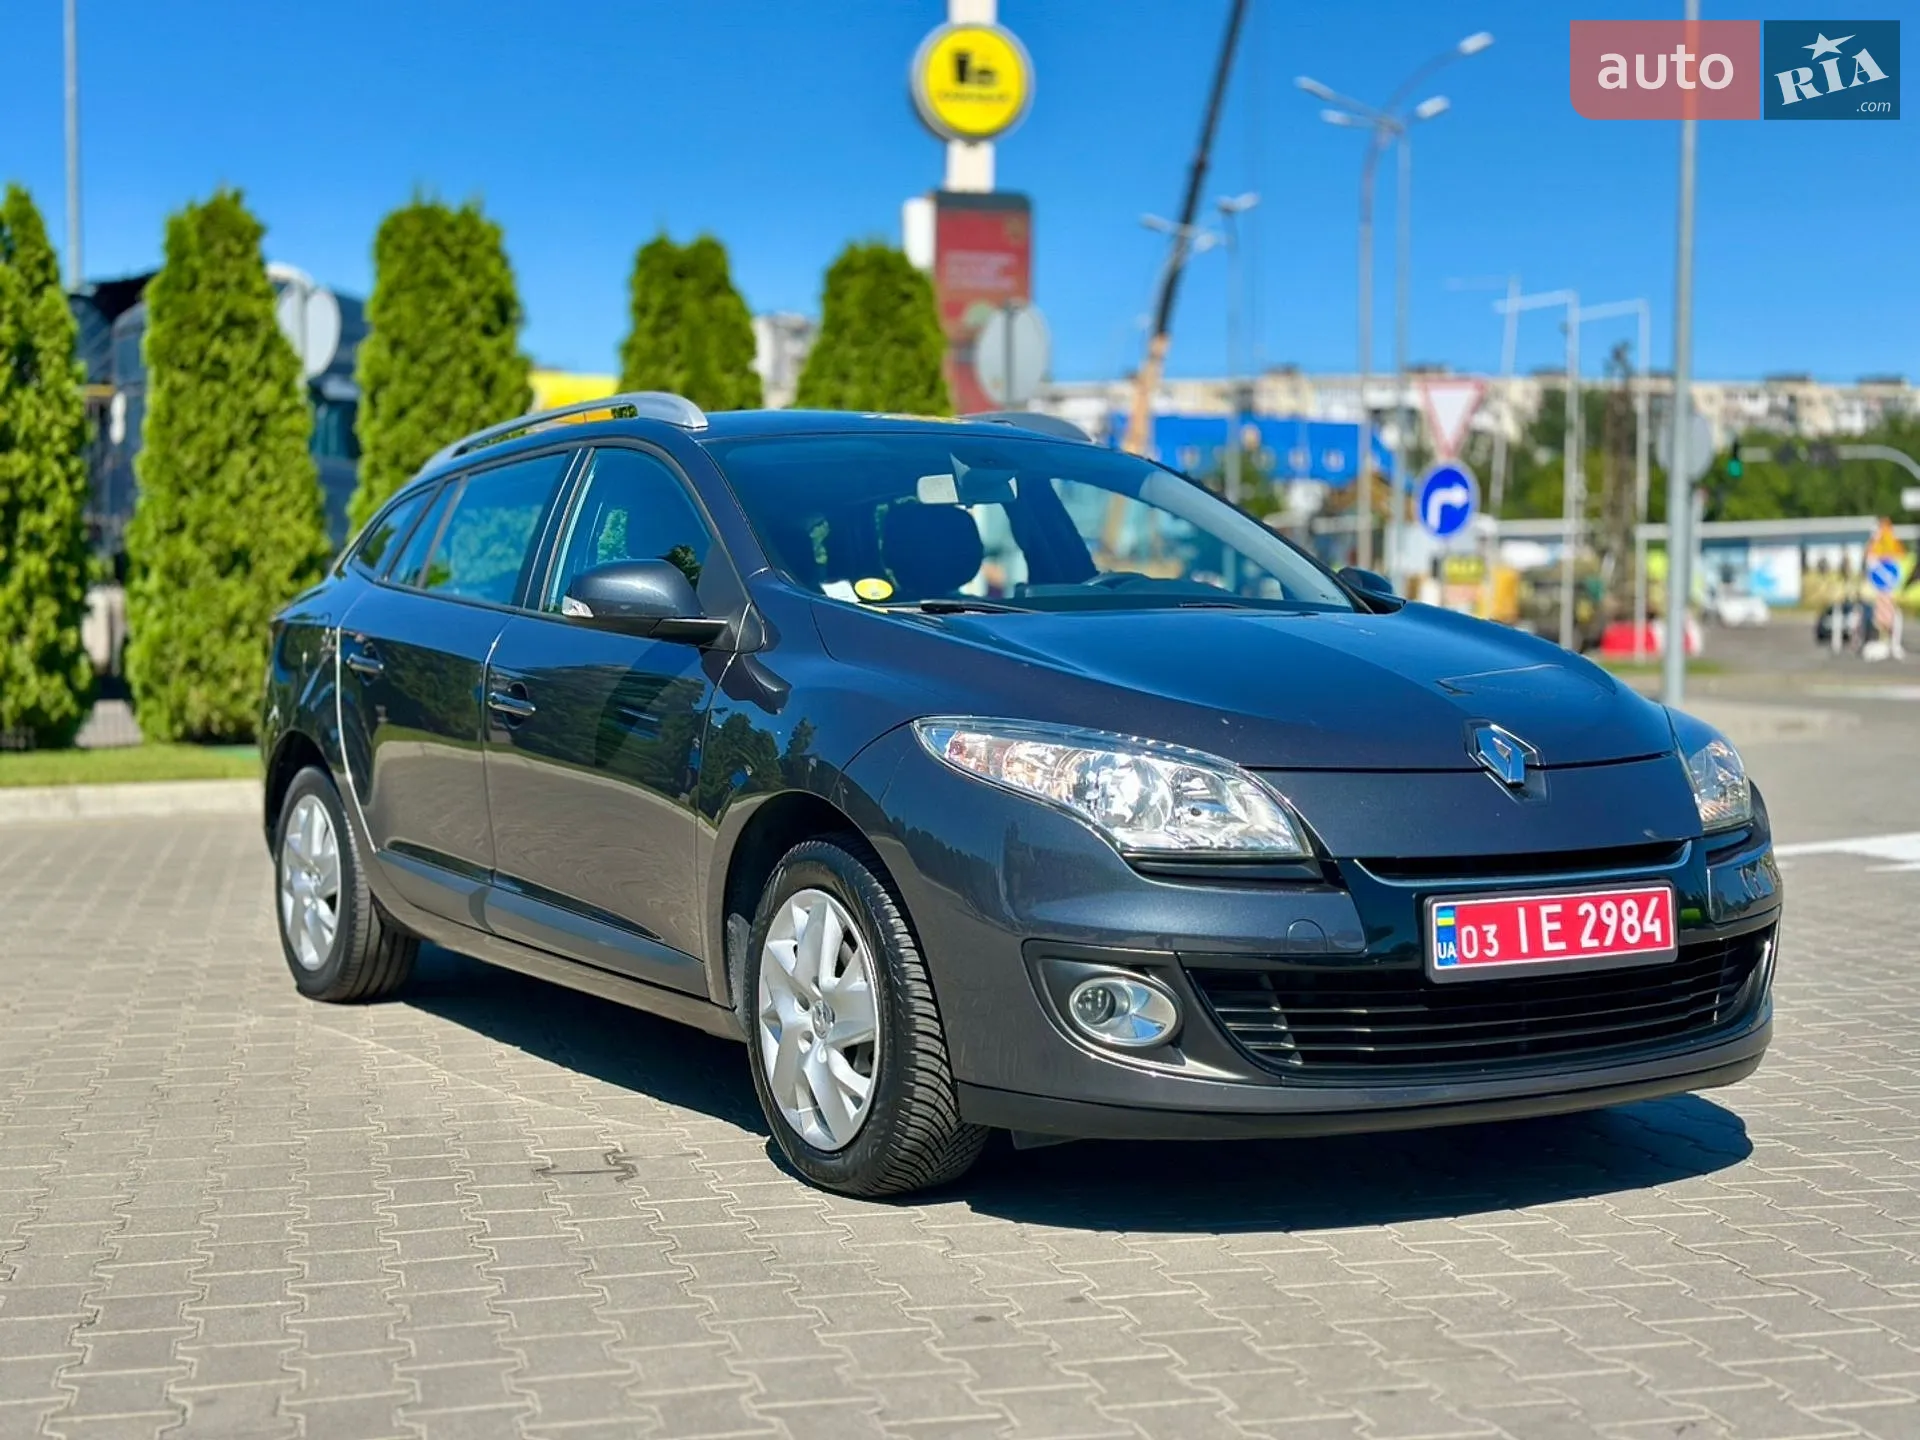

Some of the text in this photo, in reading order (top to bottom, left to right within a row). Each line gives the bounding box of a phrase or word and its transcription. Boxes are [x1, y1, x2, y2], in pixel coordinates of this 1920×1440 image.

[1461, 897, 1662, 959] 03 IE 2984
[1438, 942, 1457, 959] UA
